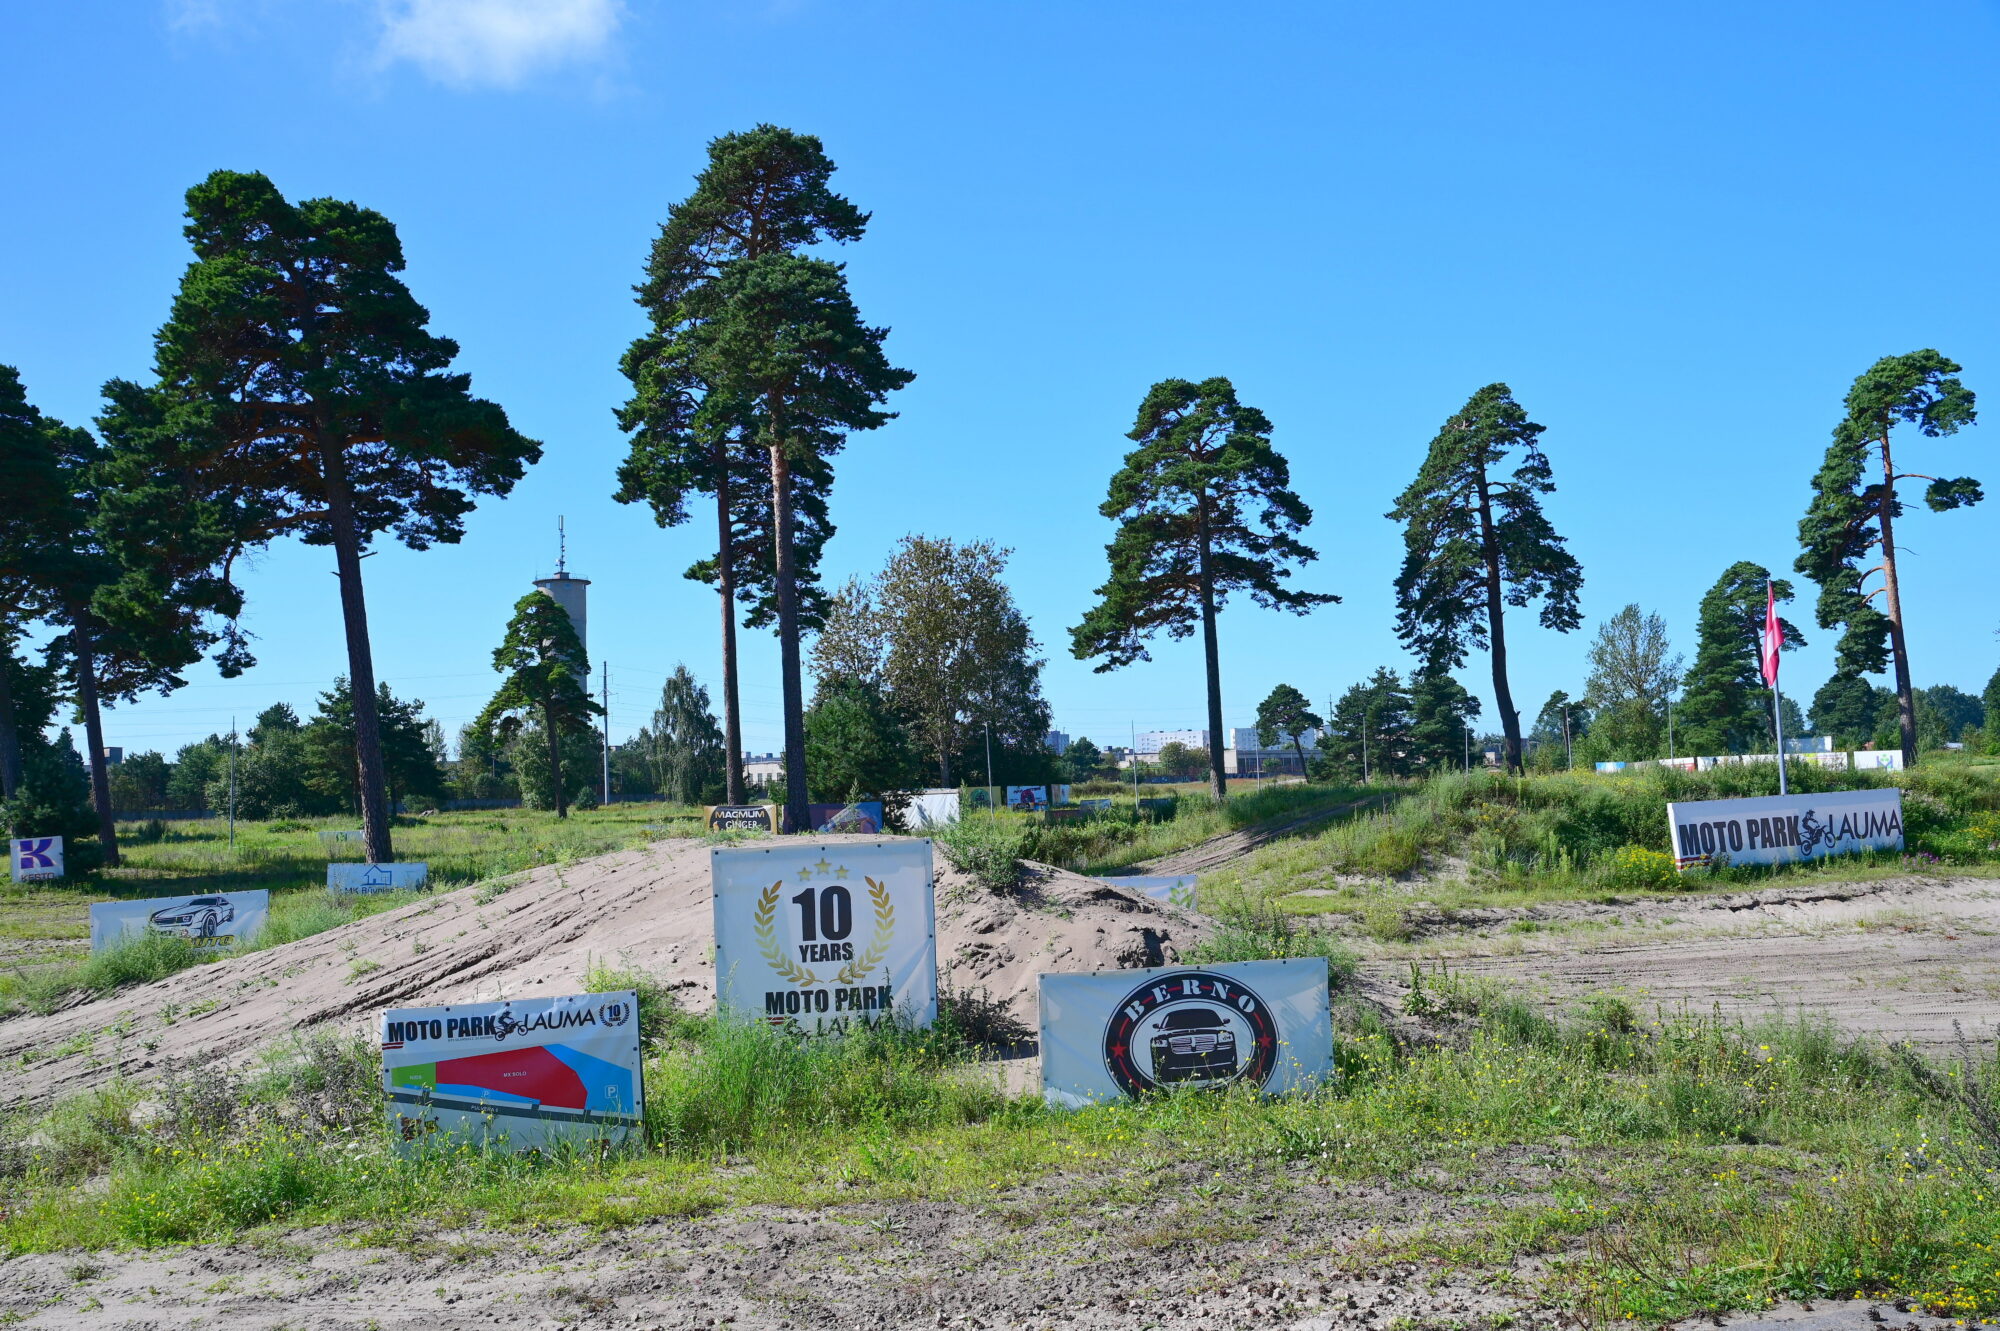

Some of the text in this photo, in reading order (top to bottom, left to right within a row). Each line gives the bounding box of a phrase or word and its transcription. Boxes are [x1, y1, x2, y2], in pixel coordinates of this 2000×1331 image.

[725, 820, 758, 829] GINGER
[1678, 815, 1801, 856] MOTO PARK
[1828, 808, 1903, 841] LAUMA
[344, 887, 359, 895] MK
[792, 885, 853, 942] 10
[189, 934, 235, 948] UTO
[799, 942, 853, 963] YEARS
[607, 1004, 621, 1018] 10
[765, 985, 894, 1016] MOTO PARK
[1124, 979, 1256, 1022] BERNO
[388, 1015, 497, 1043] MOTO PARK
[524, 1008, 597, 1031] LAUMA
[608, 1086, 616, 1097] P
